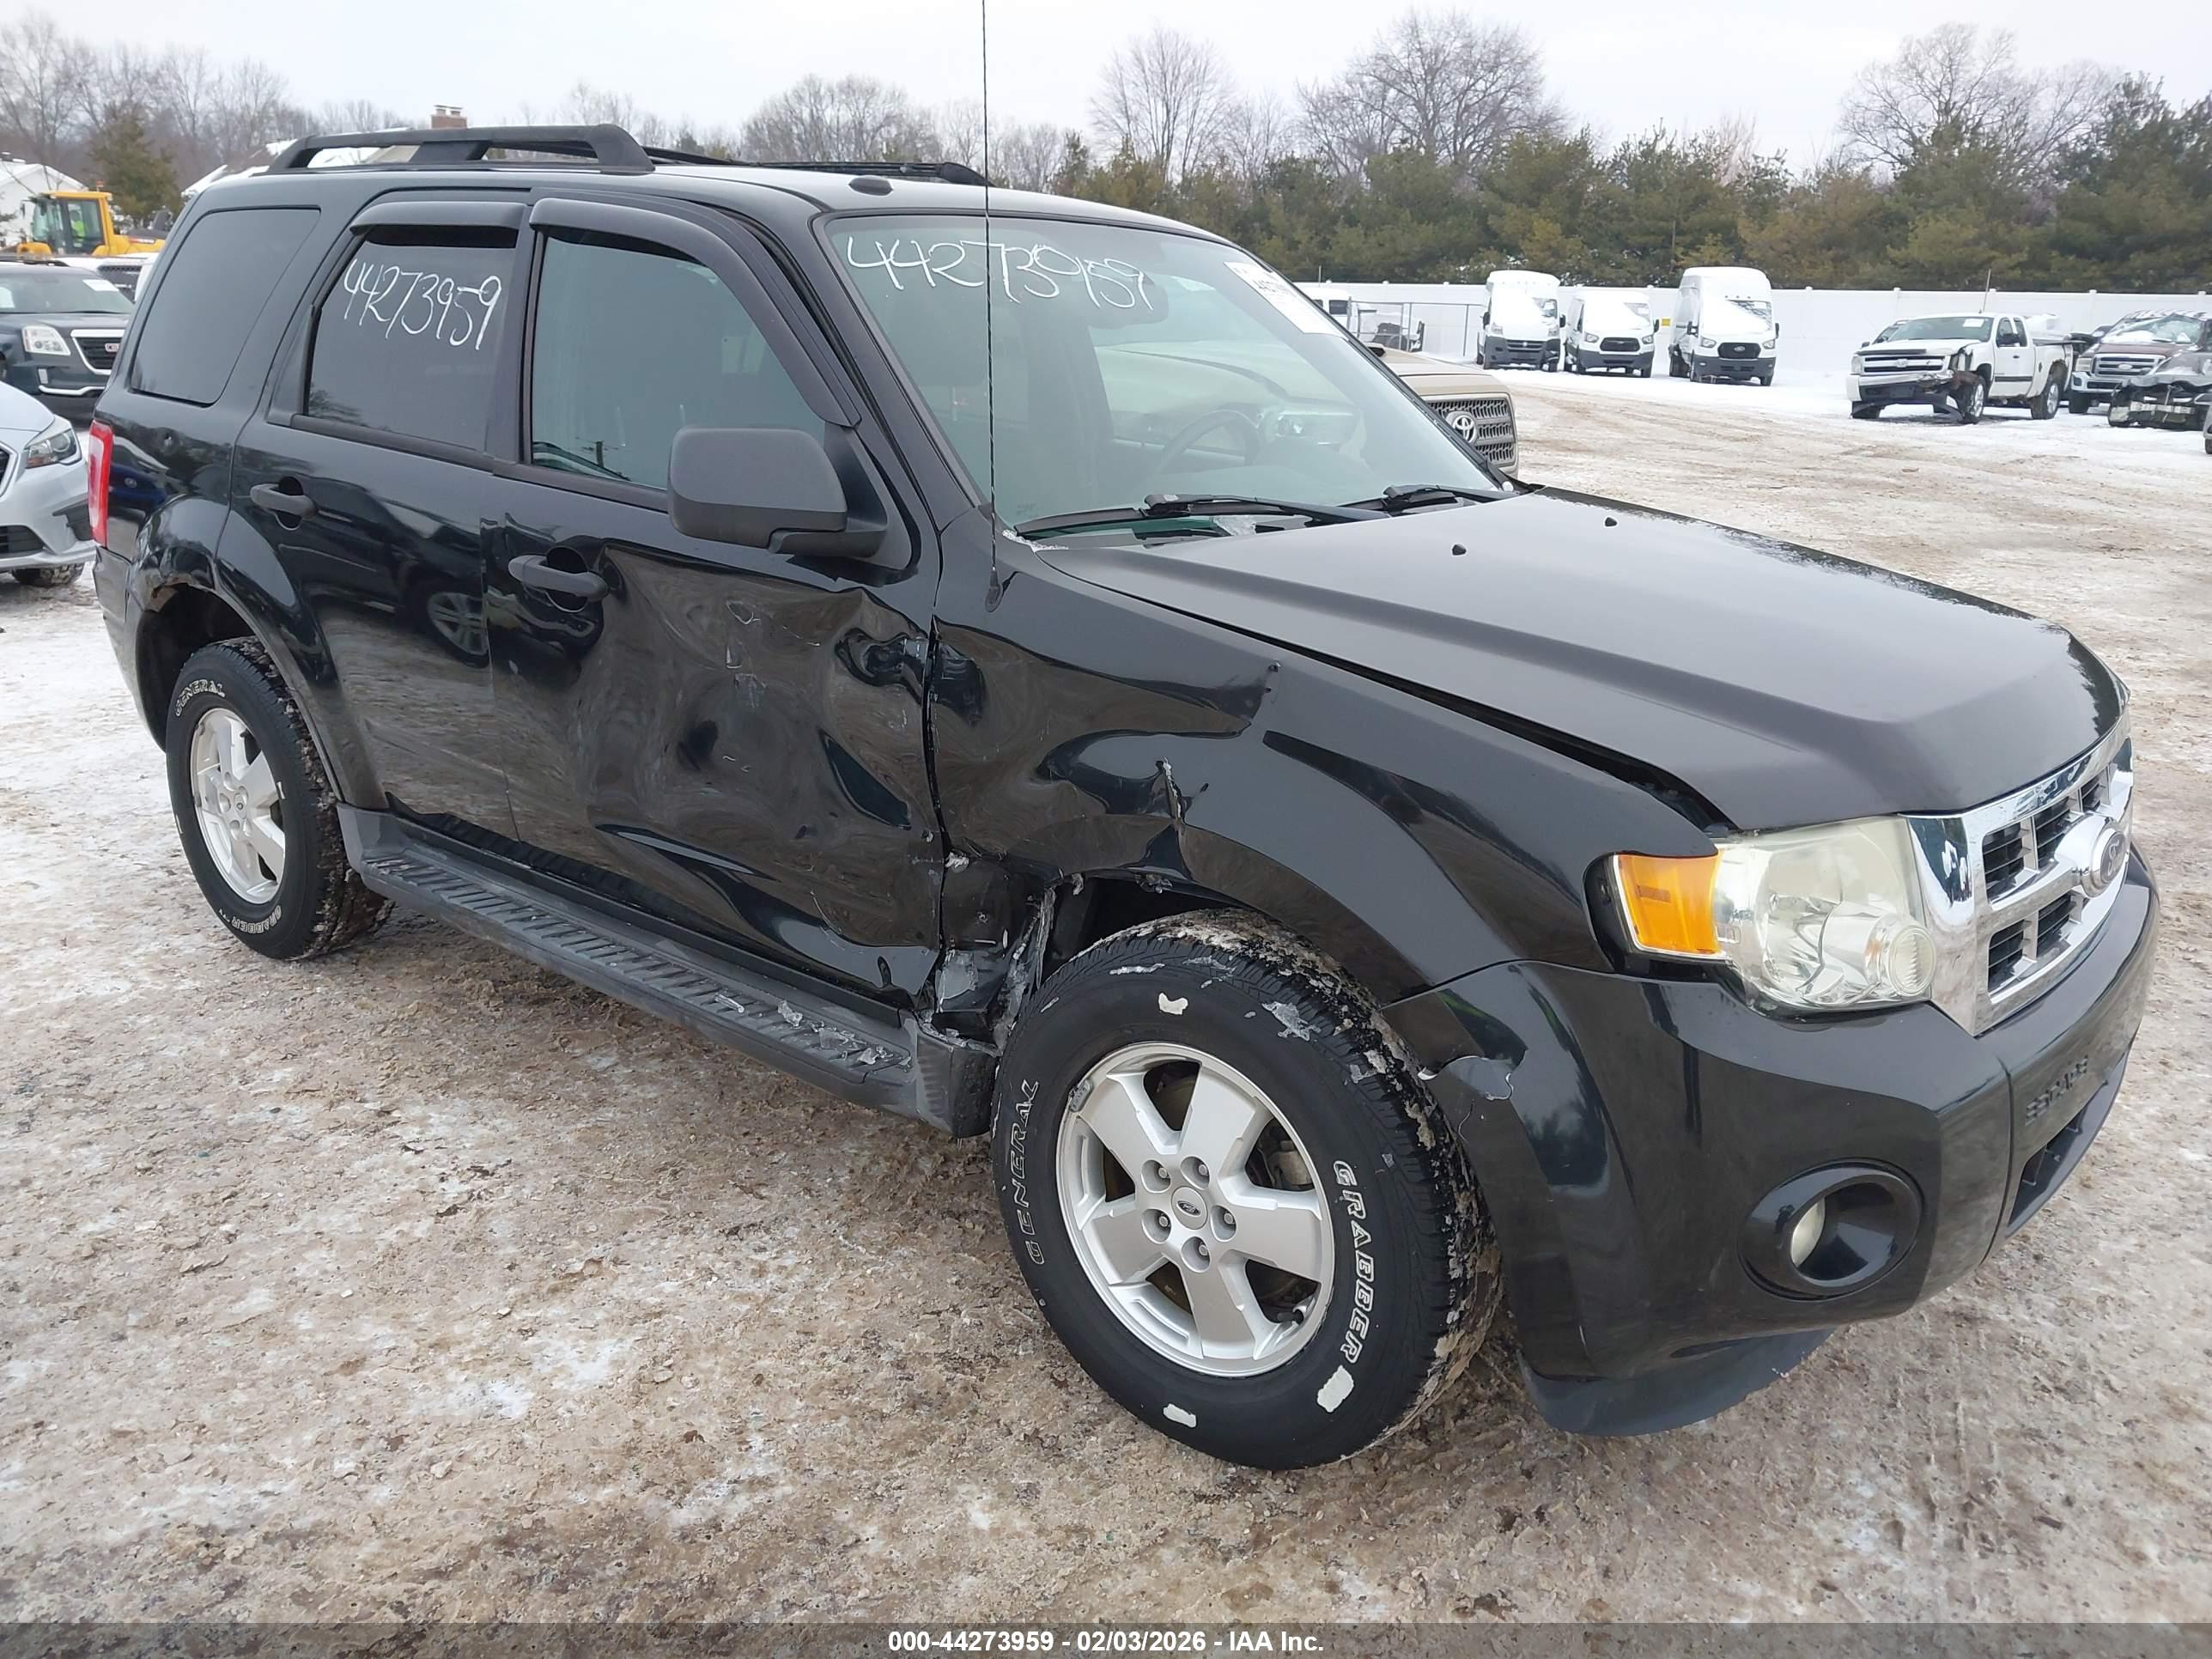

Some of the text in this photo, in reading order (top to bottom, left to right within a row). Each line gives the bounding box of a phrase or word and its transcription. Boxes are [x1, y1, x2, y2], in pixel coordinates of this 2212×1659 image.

[343, 258, 501, 350] 44273959
[848, 236, 1154, 310] 44273959
[175, 678, 225, 717] GENERAL
[231, 904, 282, 934] GRABBER
[1011, 1079, 1045, 1265] GENERAL
[1333, 1160, 1375, 1364] GRABBER
